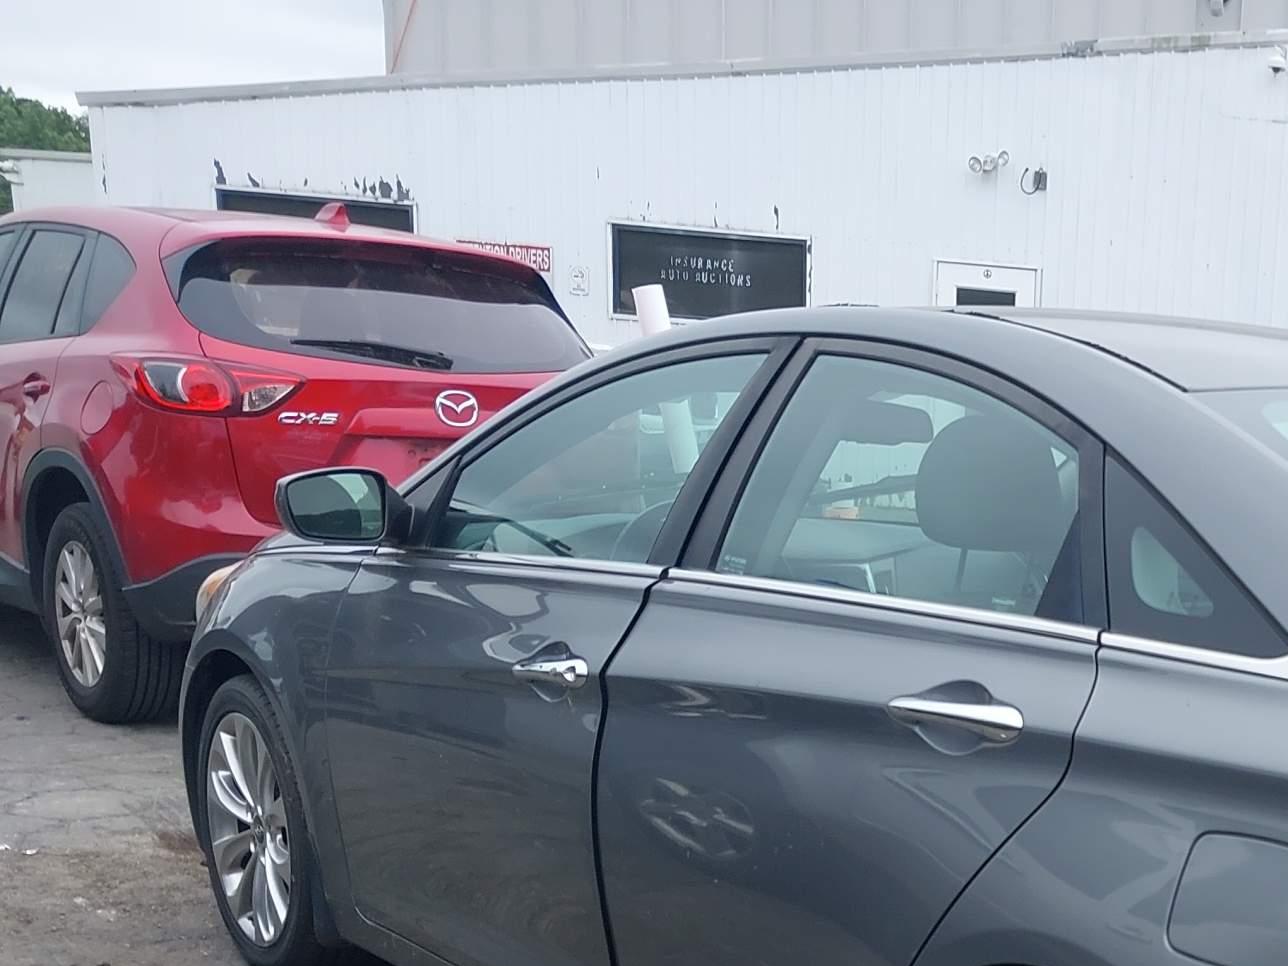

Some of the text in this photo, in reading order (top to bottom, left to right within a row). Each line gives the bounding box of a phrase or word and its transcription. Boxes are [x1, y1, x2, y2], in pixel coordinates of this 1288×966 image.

[509, 246, 550, 270] DRIVERS
[670, 256, 734, 273] INSURANCE
[660, 268, 752, 287] AUTO AUCTIONS
[277, 411, 340, 425] CX-5
